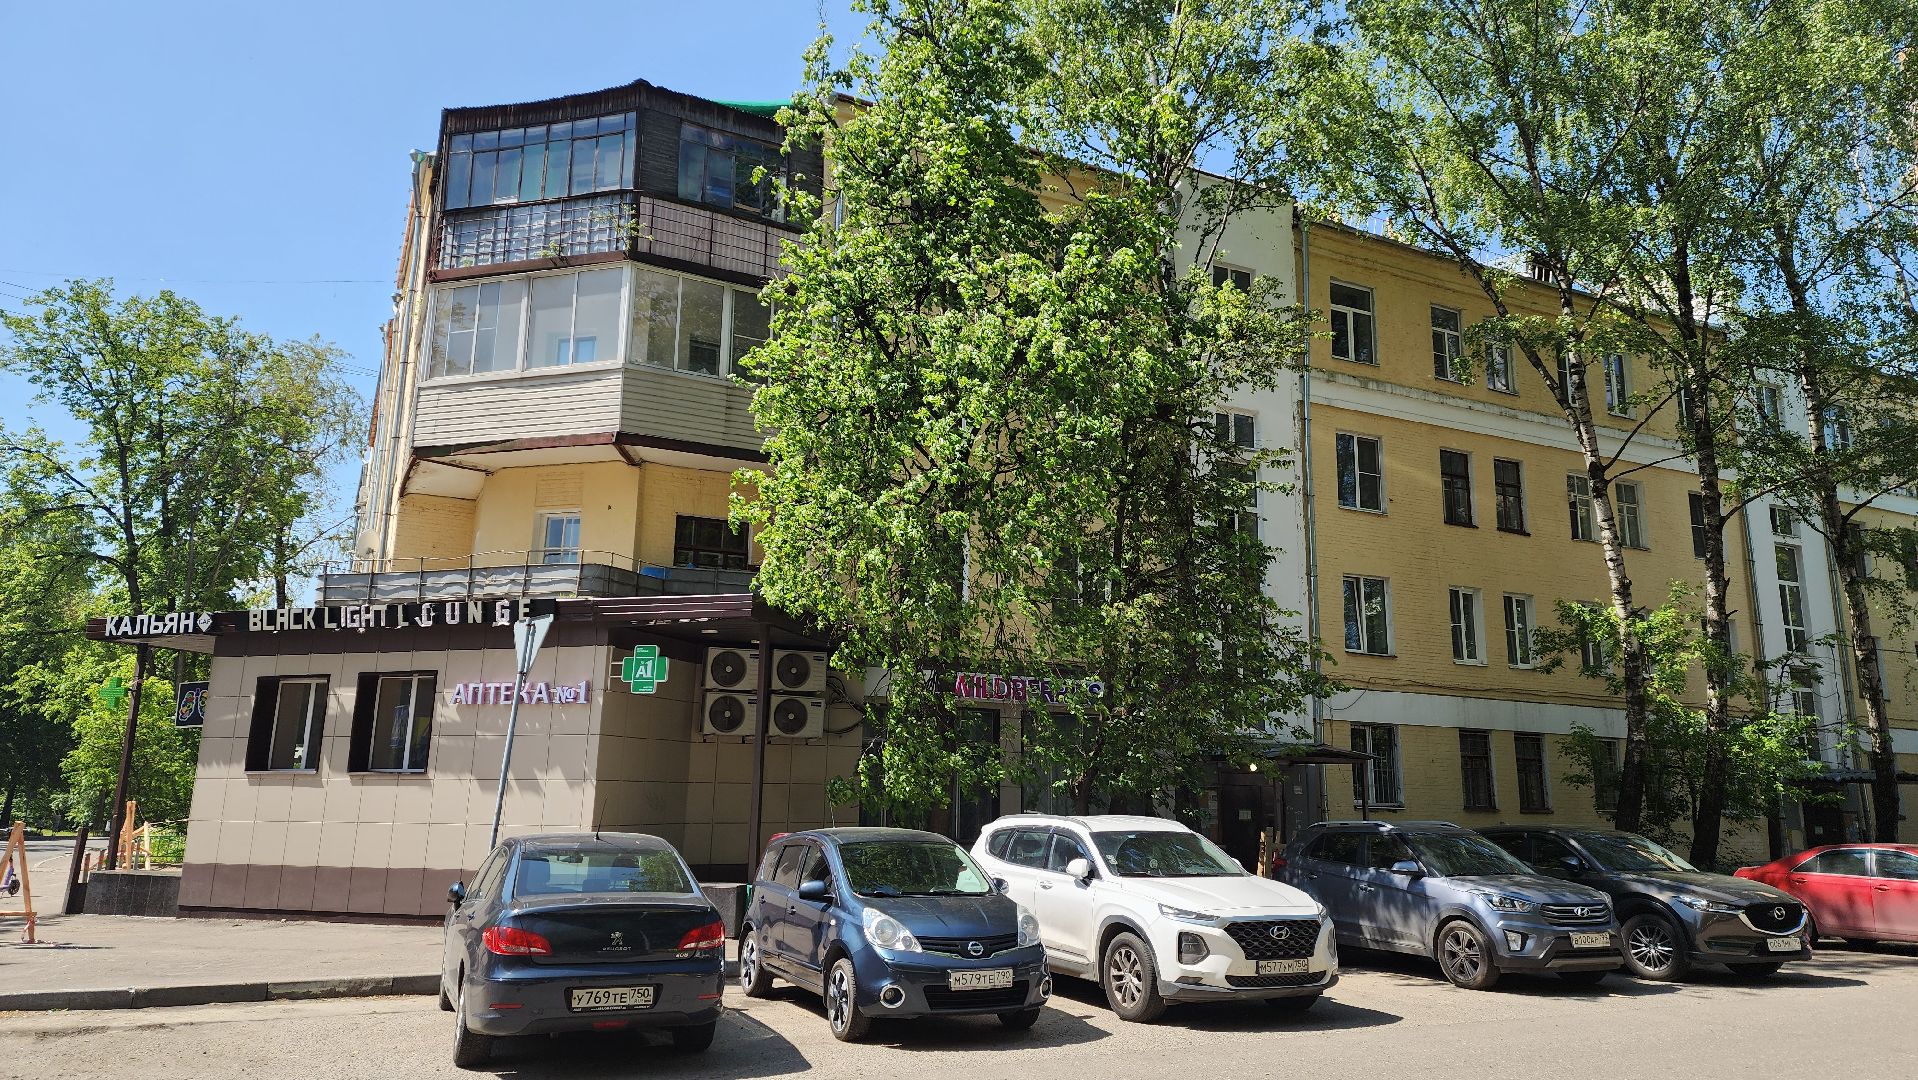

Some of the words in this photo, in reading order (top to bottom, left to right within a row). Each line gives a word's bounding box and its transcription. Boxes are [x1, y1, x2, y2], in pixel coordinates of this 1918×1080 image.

[105, 612, 195, 636] КАЛЬЯН
[248, 607, 316, 631] BLACK
[324, 603, 388, 628] LIGHT
[396, 599, 531, 627] LOUNGE
[450, 682, 549, 705] АПТЕКА
[954, 973, 994, 986] М579ТЕ
[576, 990, 628, 1006] У769ТЕ
[630, 987, 650, 999] 750
